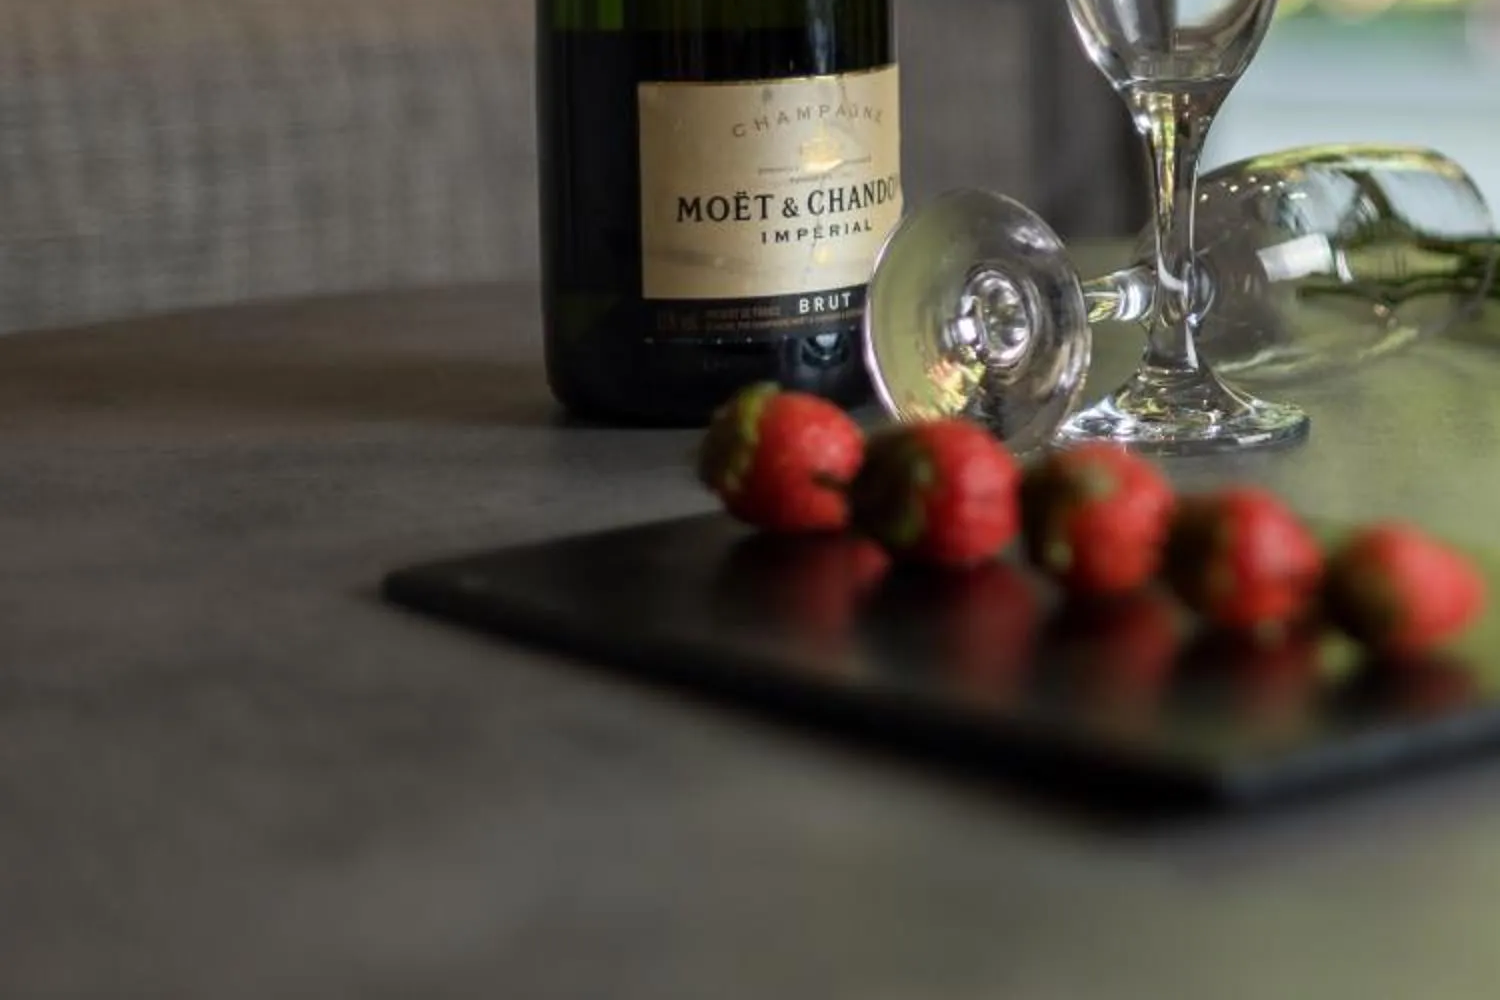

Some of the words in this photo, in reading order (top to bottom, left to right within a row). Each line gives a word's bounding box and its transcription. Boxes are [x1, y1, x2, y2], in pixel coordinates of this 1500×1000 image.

[732, 104, 883, 138] CHAMPAGNE
[676, 190, 774, 223] MOËT
[782, 197, 800, 219] &
[807, 175, 898, 216] CHANDO
[799, 291, 852, 315] BRUT
